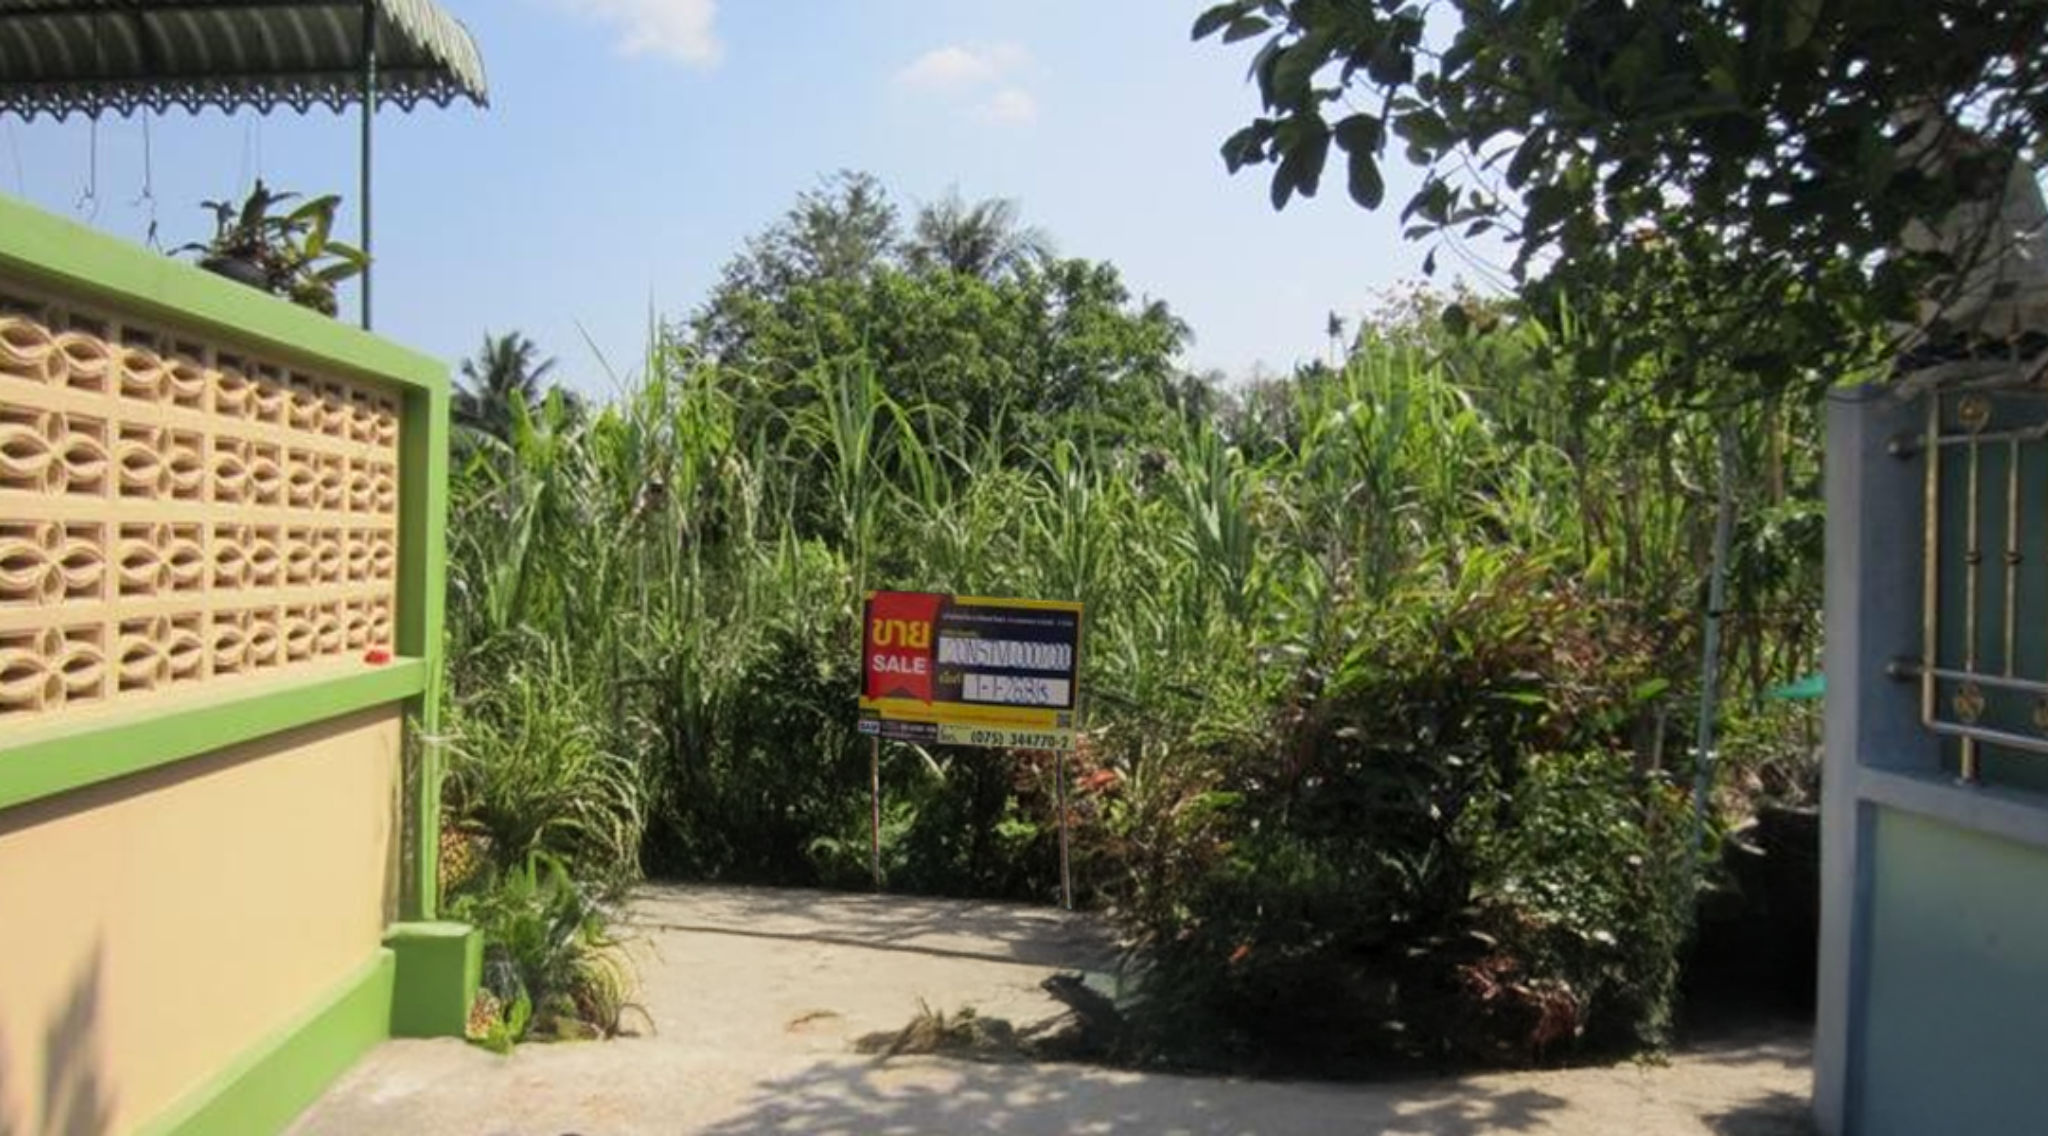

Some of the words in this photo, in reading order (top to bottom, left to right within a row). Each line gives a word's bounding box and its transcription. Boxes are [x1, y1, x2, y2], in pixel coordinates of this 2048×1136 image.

[873, 618, 930, 648] ขาย
[872, 654, 927, 675] SALE
[971, 730, 1004, 745] (075)
